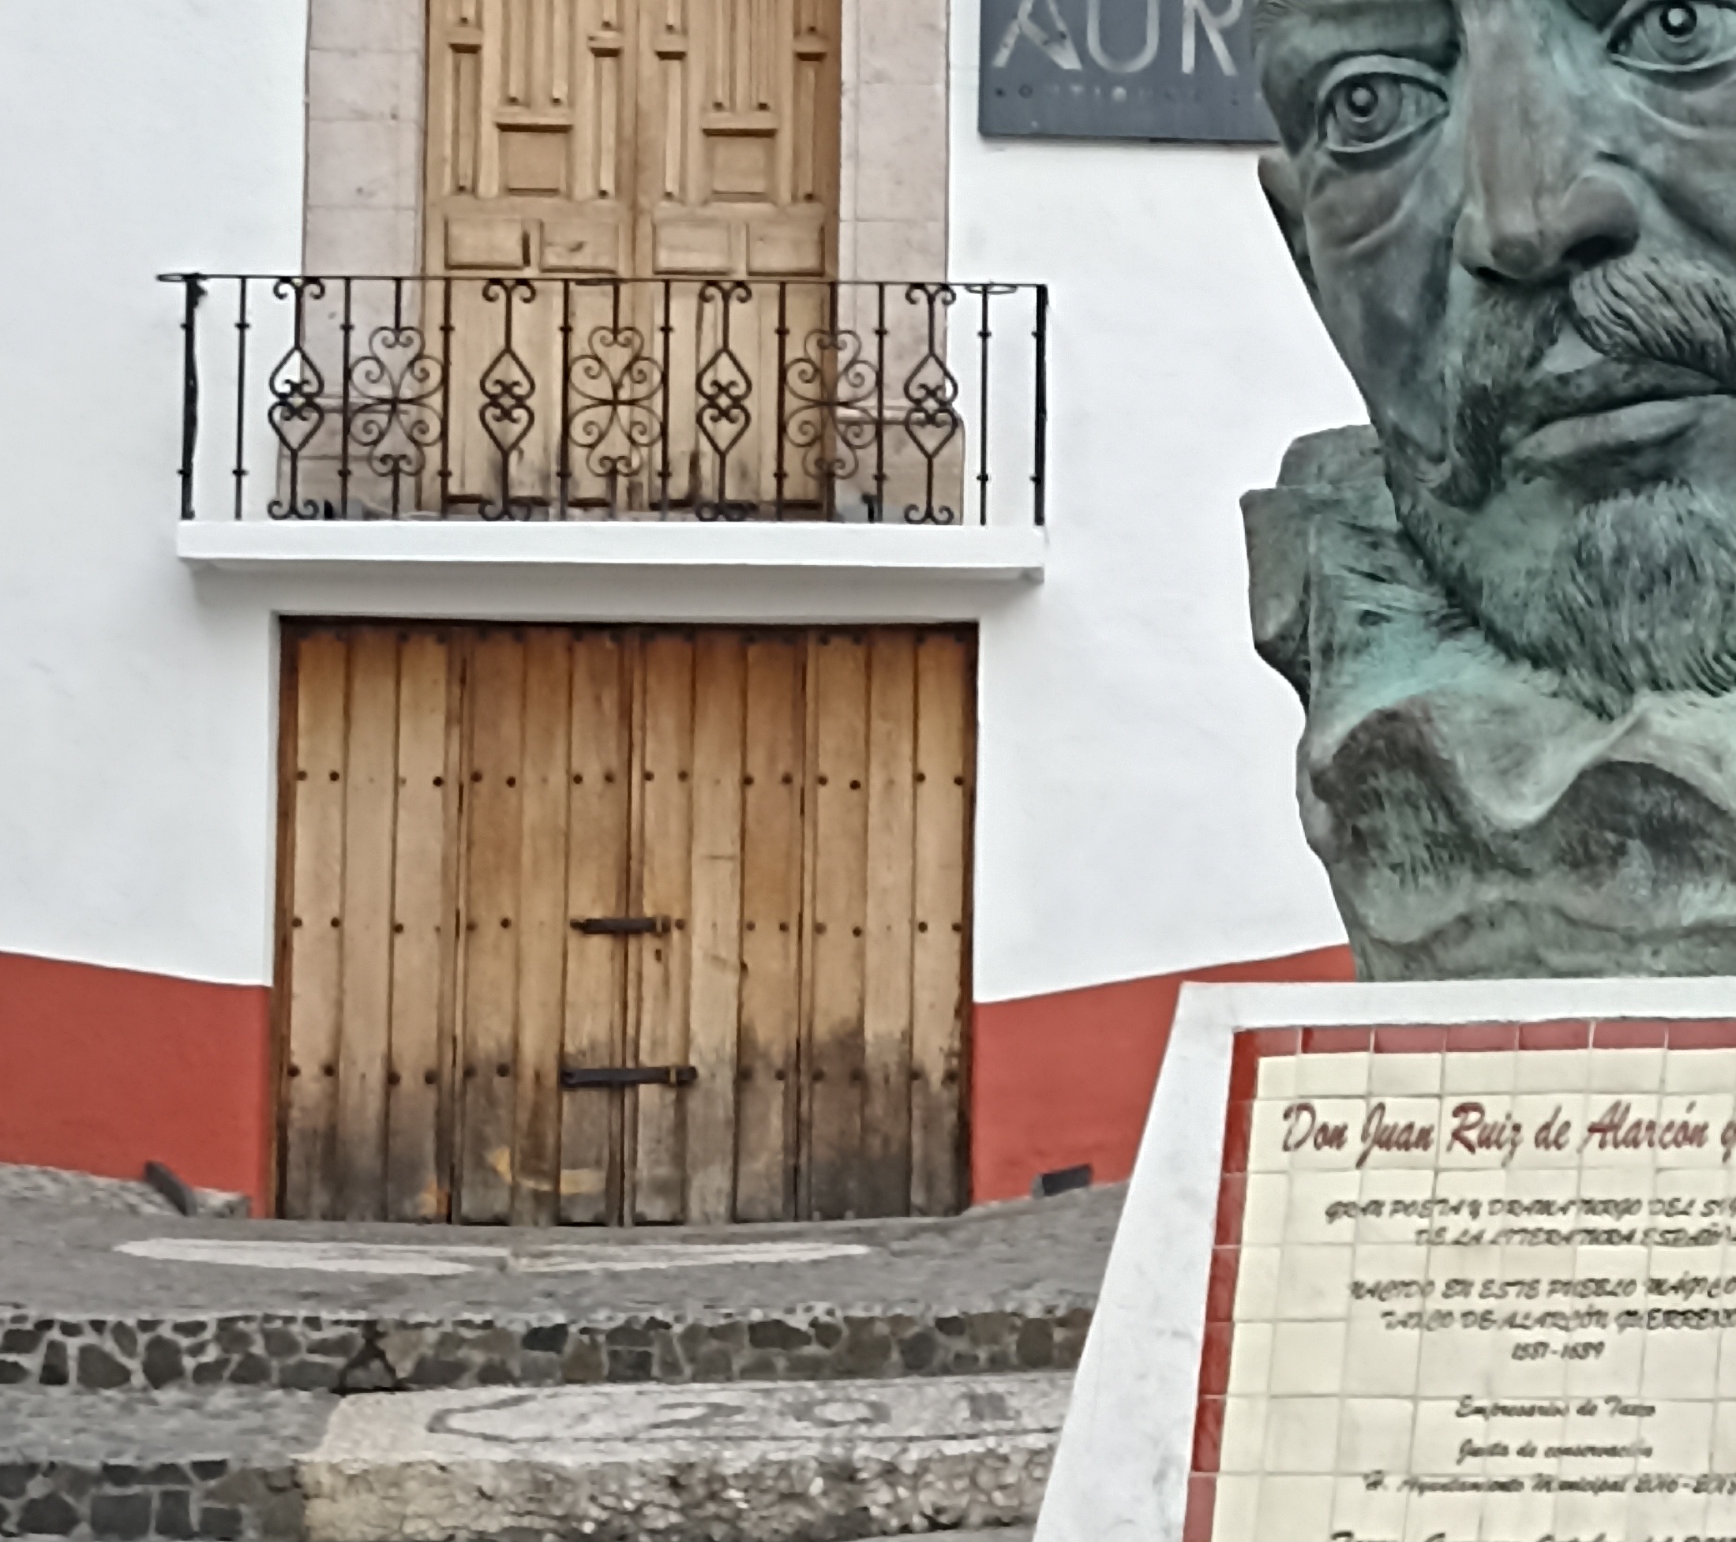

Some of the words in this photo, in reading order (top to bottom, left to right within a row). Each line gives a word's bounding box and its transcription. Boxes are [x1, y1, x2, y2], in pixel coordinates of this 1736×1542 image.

[1283, 1102, 1350, 1152] Don
[1354, 1102, 1434, 1169] Juan
[1446, 1102, 1522, 1167] Ruiz
[1534, 1104, 1571, 1150] de
[1576, 1100, 1709, 1154] Alarcón
[1648, 1198, 1697, 1216] DEL
[1415, 1227, 1447, 1246] DE
[1450, 1227, 1487, 1246] LA
[1441, 1278, 1475, 1299] EN
[1478, 1278, 1541, 1299] ESTE
[1547, 1277, 1637, 1299] PUEBLO
[1460, 1309, 1497, 1330] DE
[1576, 1397, 1599, 1416] de
[1516, 1439, 1538, 1458] de
